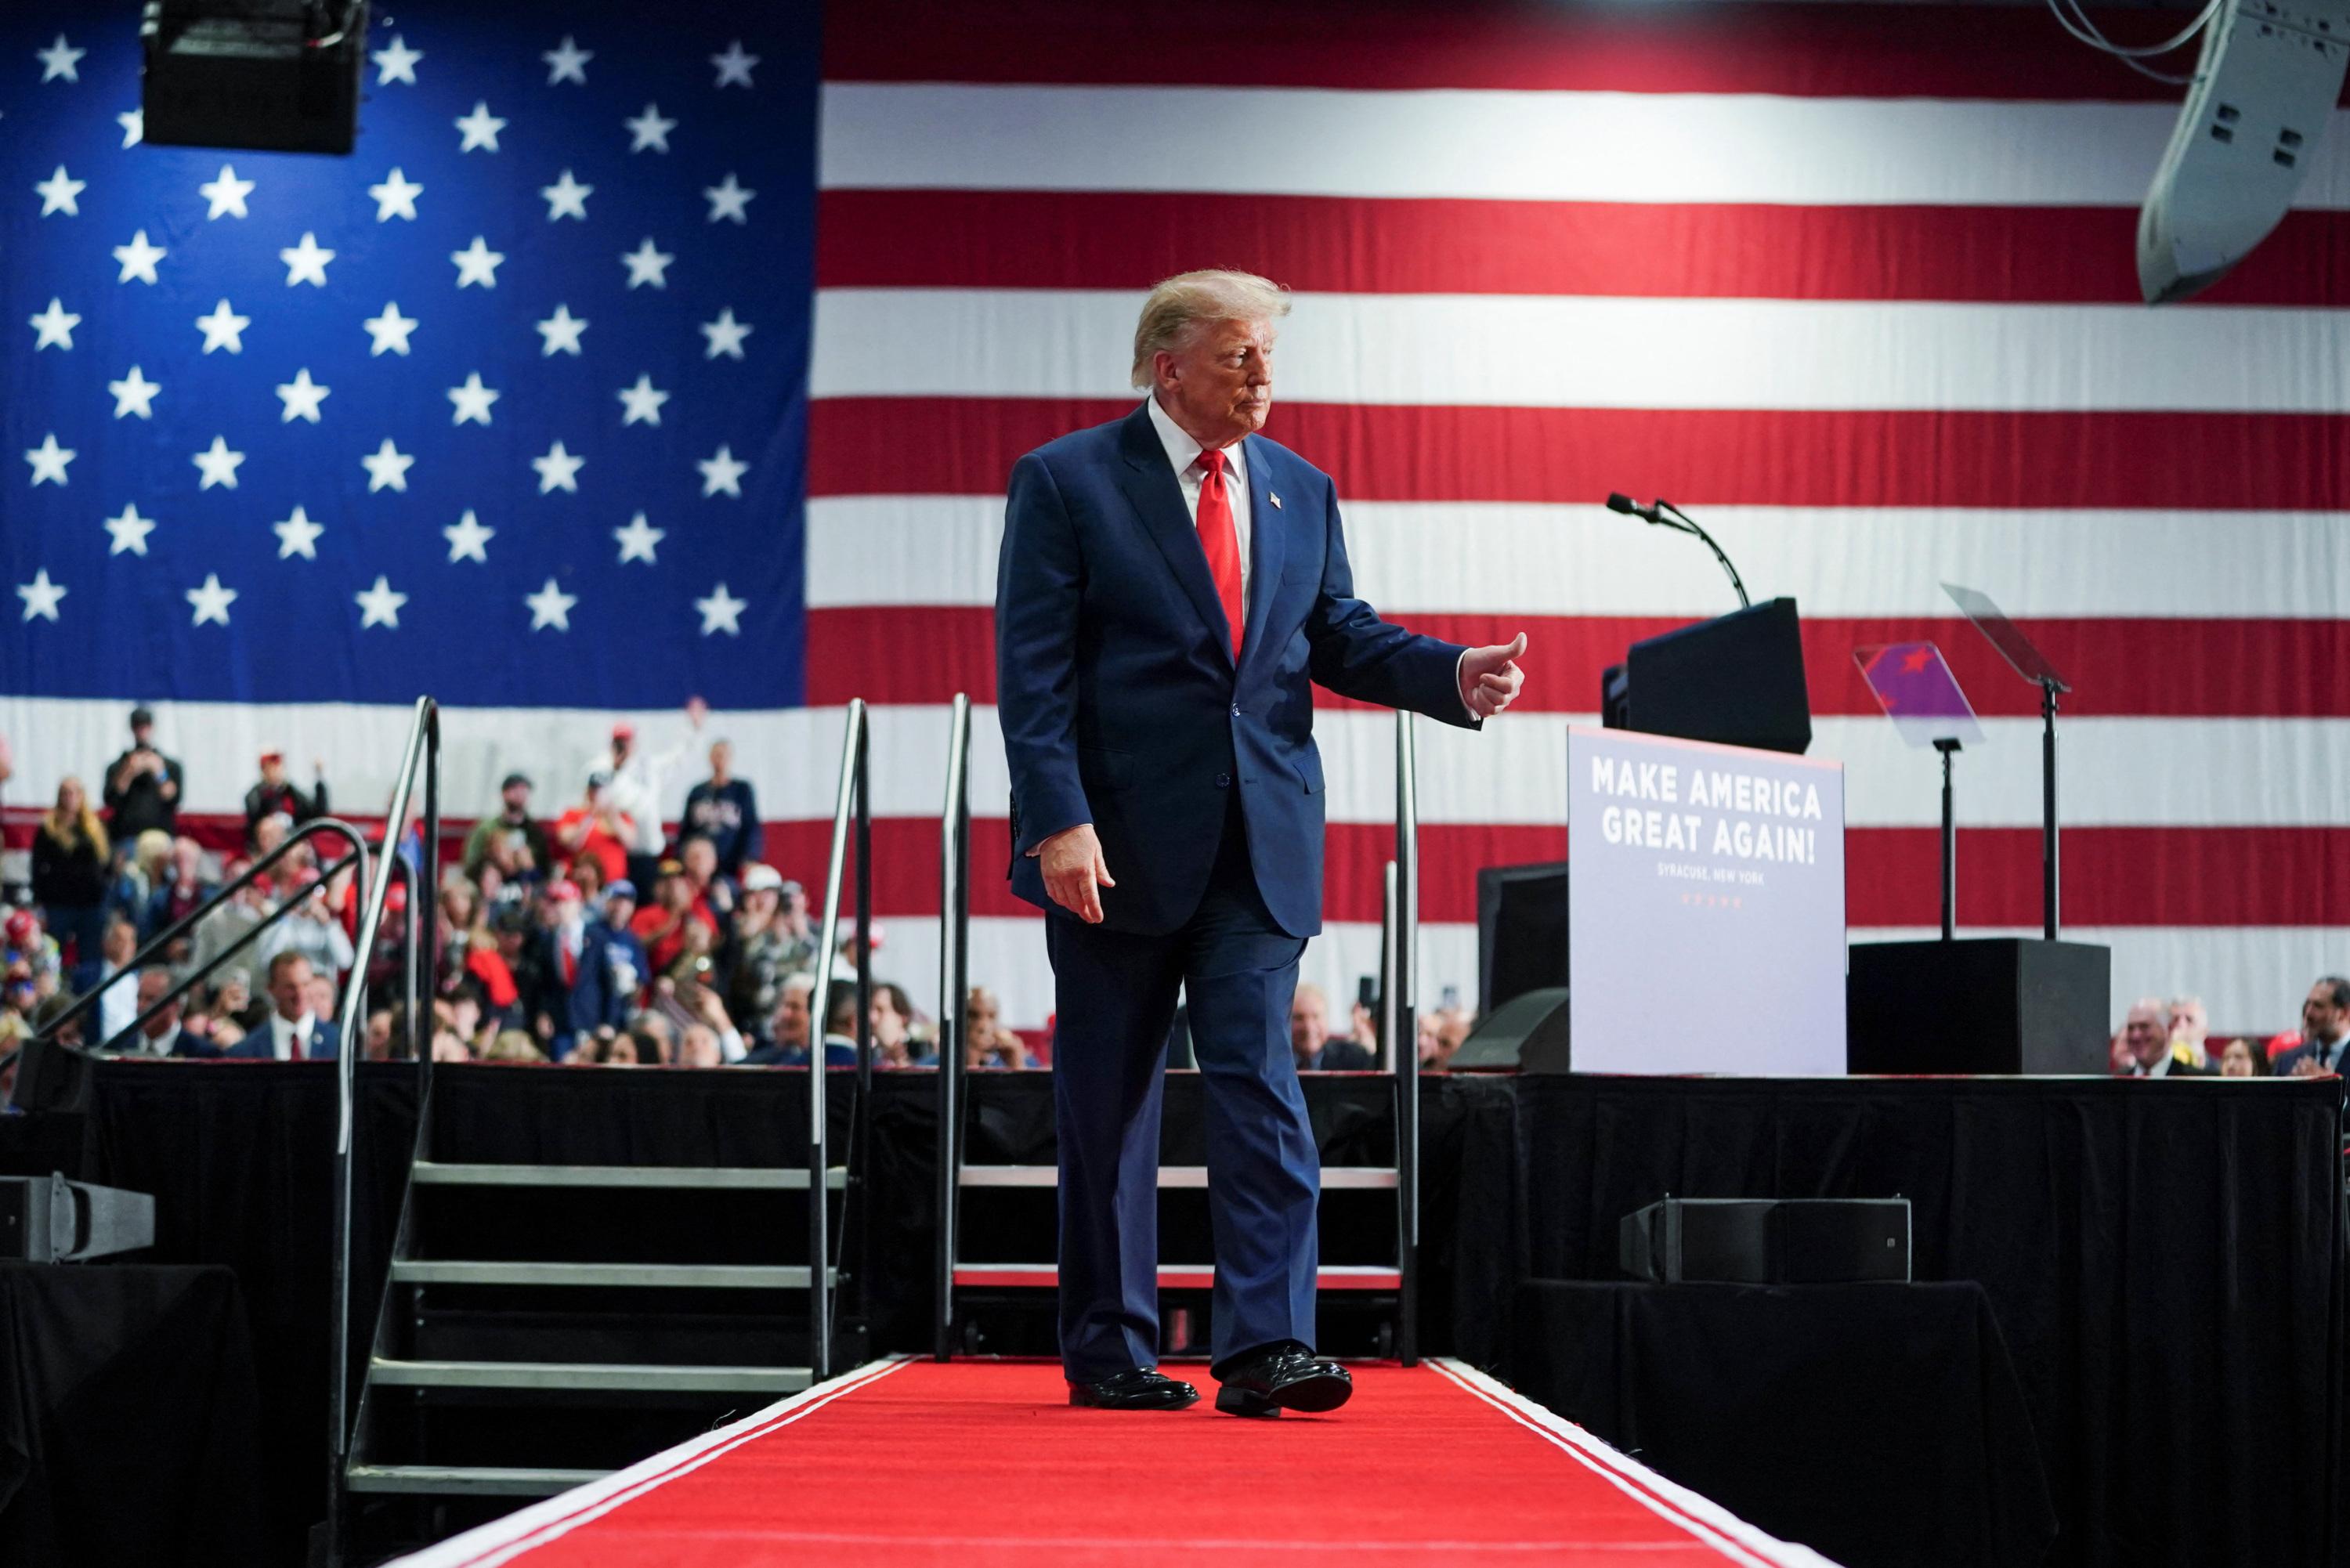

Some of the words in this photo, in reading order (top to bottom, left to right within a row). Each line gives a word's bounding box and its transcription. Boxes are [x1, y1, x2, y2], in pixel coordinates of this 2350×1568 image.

[1592, 756, 1678, 804] MAKE
[1689, 769, 1822, 821] AMERICA
[1602, 805, 1701, 852] GREAT
[1712, 818, 1815, 865] AGAIN!
[1713, 868, 1736, 883] NEW
[1739, 870, 1765, 886] YORK
